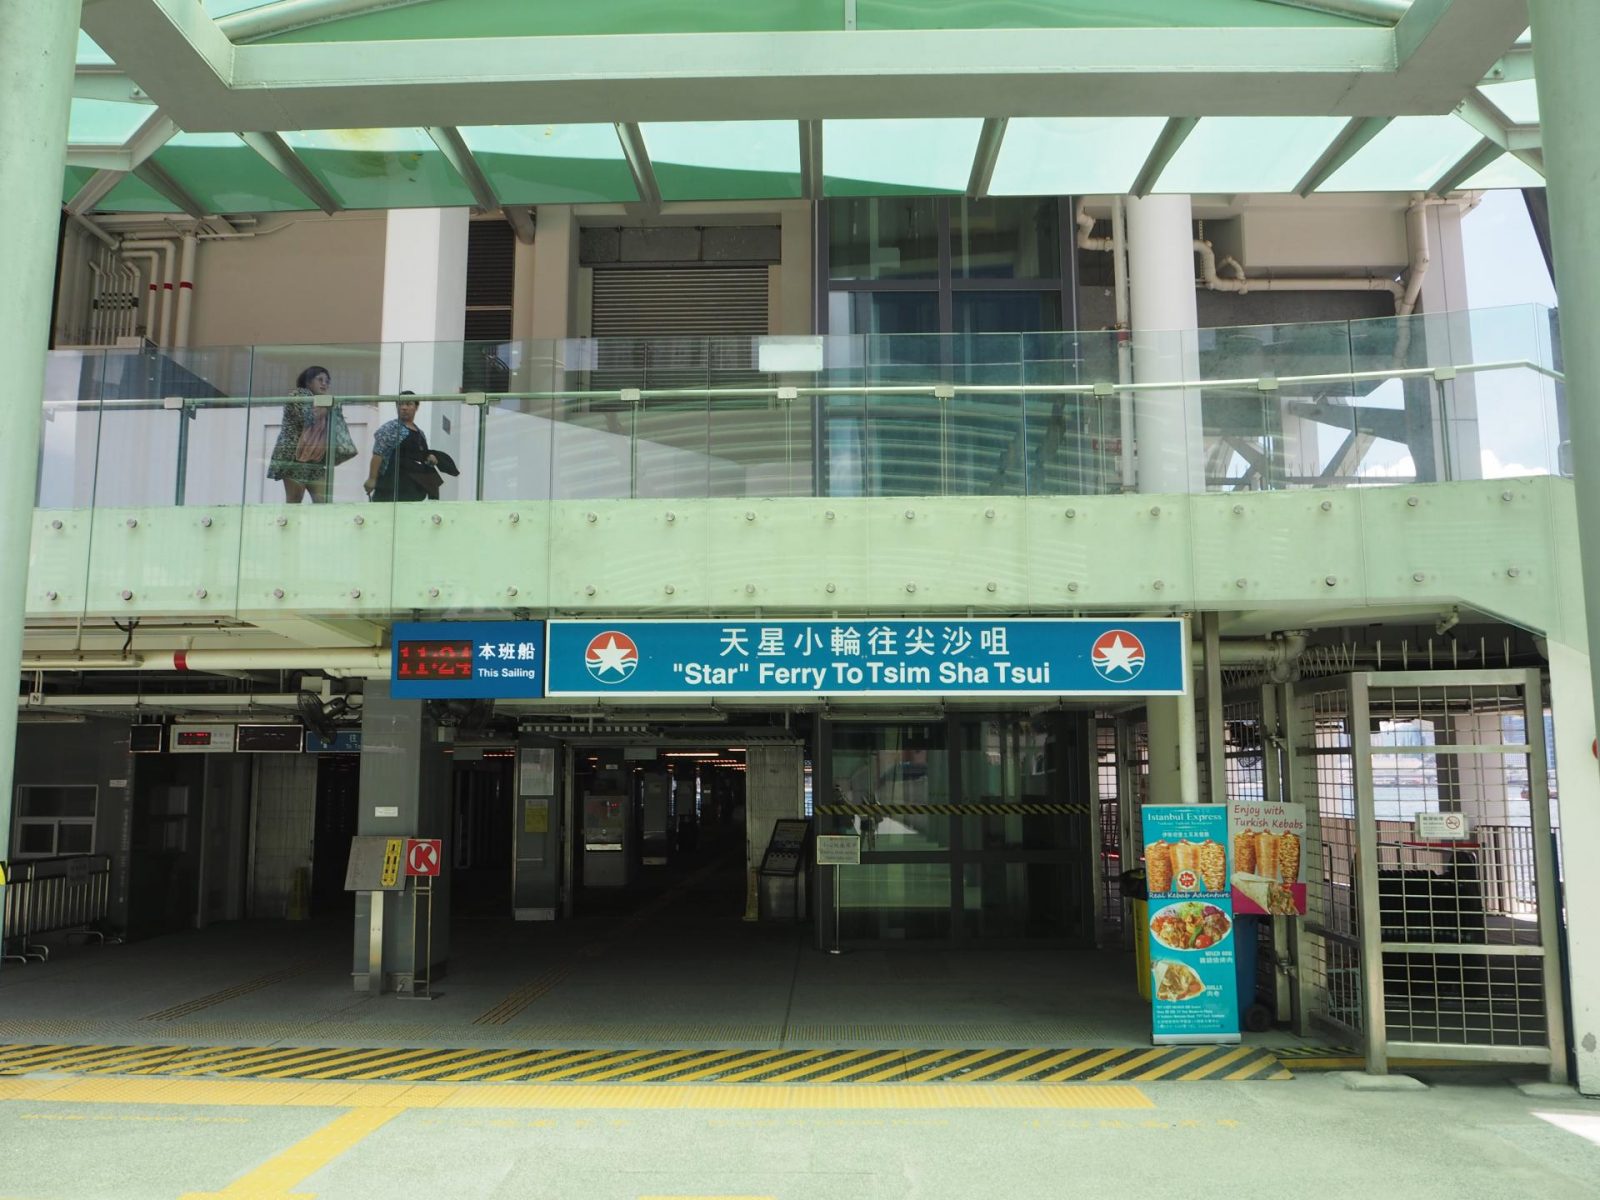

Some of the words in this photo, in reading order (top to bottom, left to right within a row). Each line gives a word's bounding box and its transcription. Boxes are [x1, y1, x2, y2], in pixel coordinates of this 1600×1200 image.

[719, 626, 1010, 657] 天星小輪往尖沙咀
[478, 642, 536, 661] 本班船
[478, 668, 499, 678] This
[502, 668, 535, 680] Sailing
[673, 663, 749, 684] "Star"
[759, 663, 827, 689] Ferry
[832, 663, 863, 684] To
[869, 662, 930, 684] Tsim
[939, 662, 989, 684] Sha
[994, 662, 1050, 684] Tsui
[1234, 804, 1260, 817] Enjoy
[1264, 806, 1285, 816] with
[1148, 812, 1184, 821] Istanbul
[1186, 812, 1223, 822] Express
[1235, 817, 1268, 827] Turkish
[1272, 819, 1304, 829] Kebabs
[1167, 891, 1191, 899] Kebab
